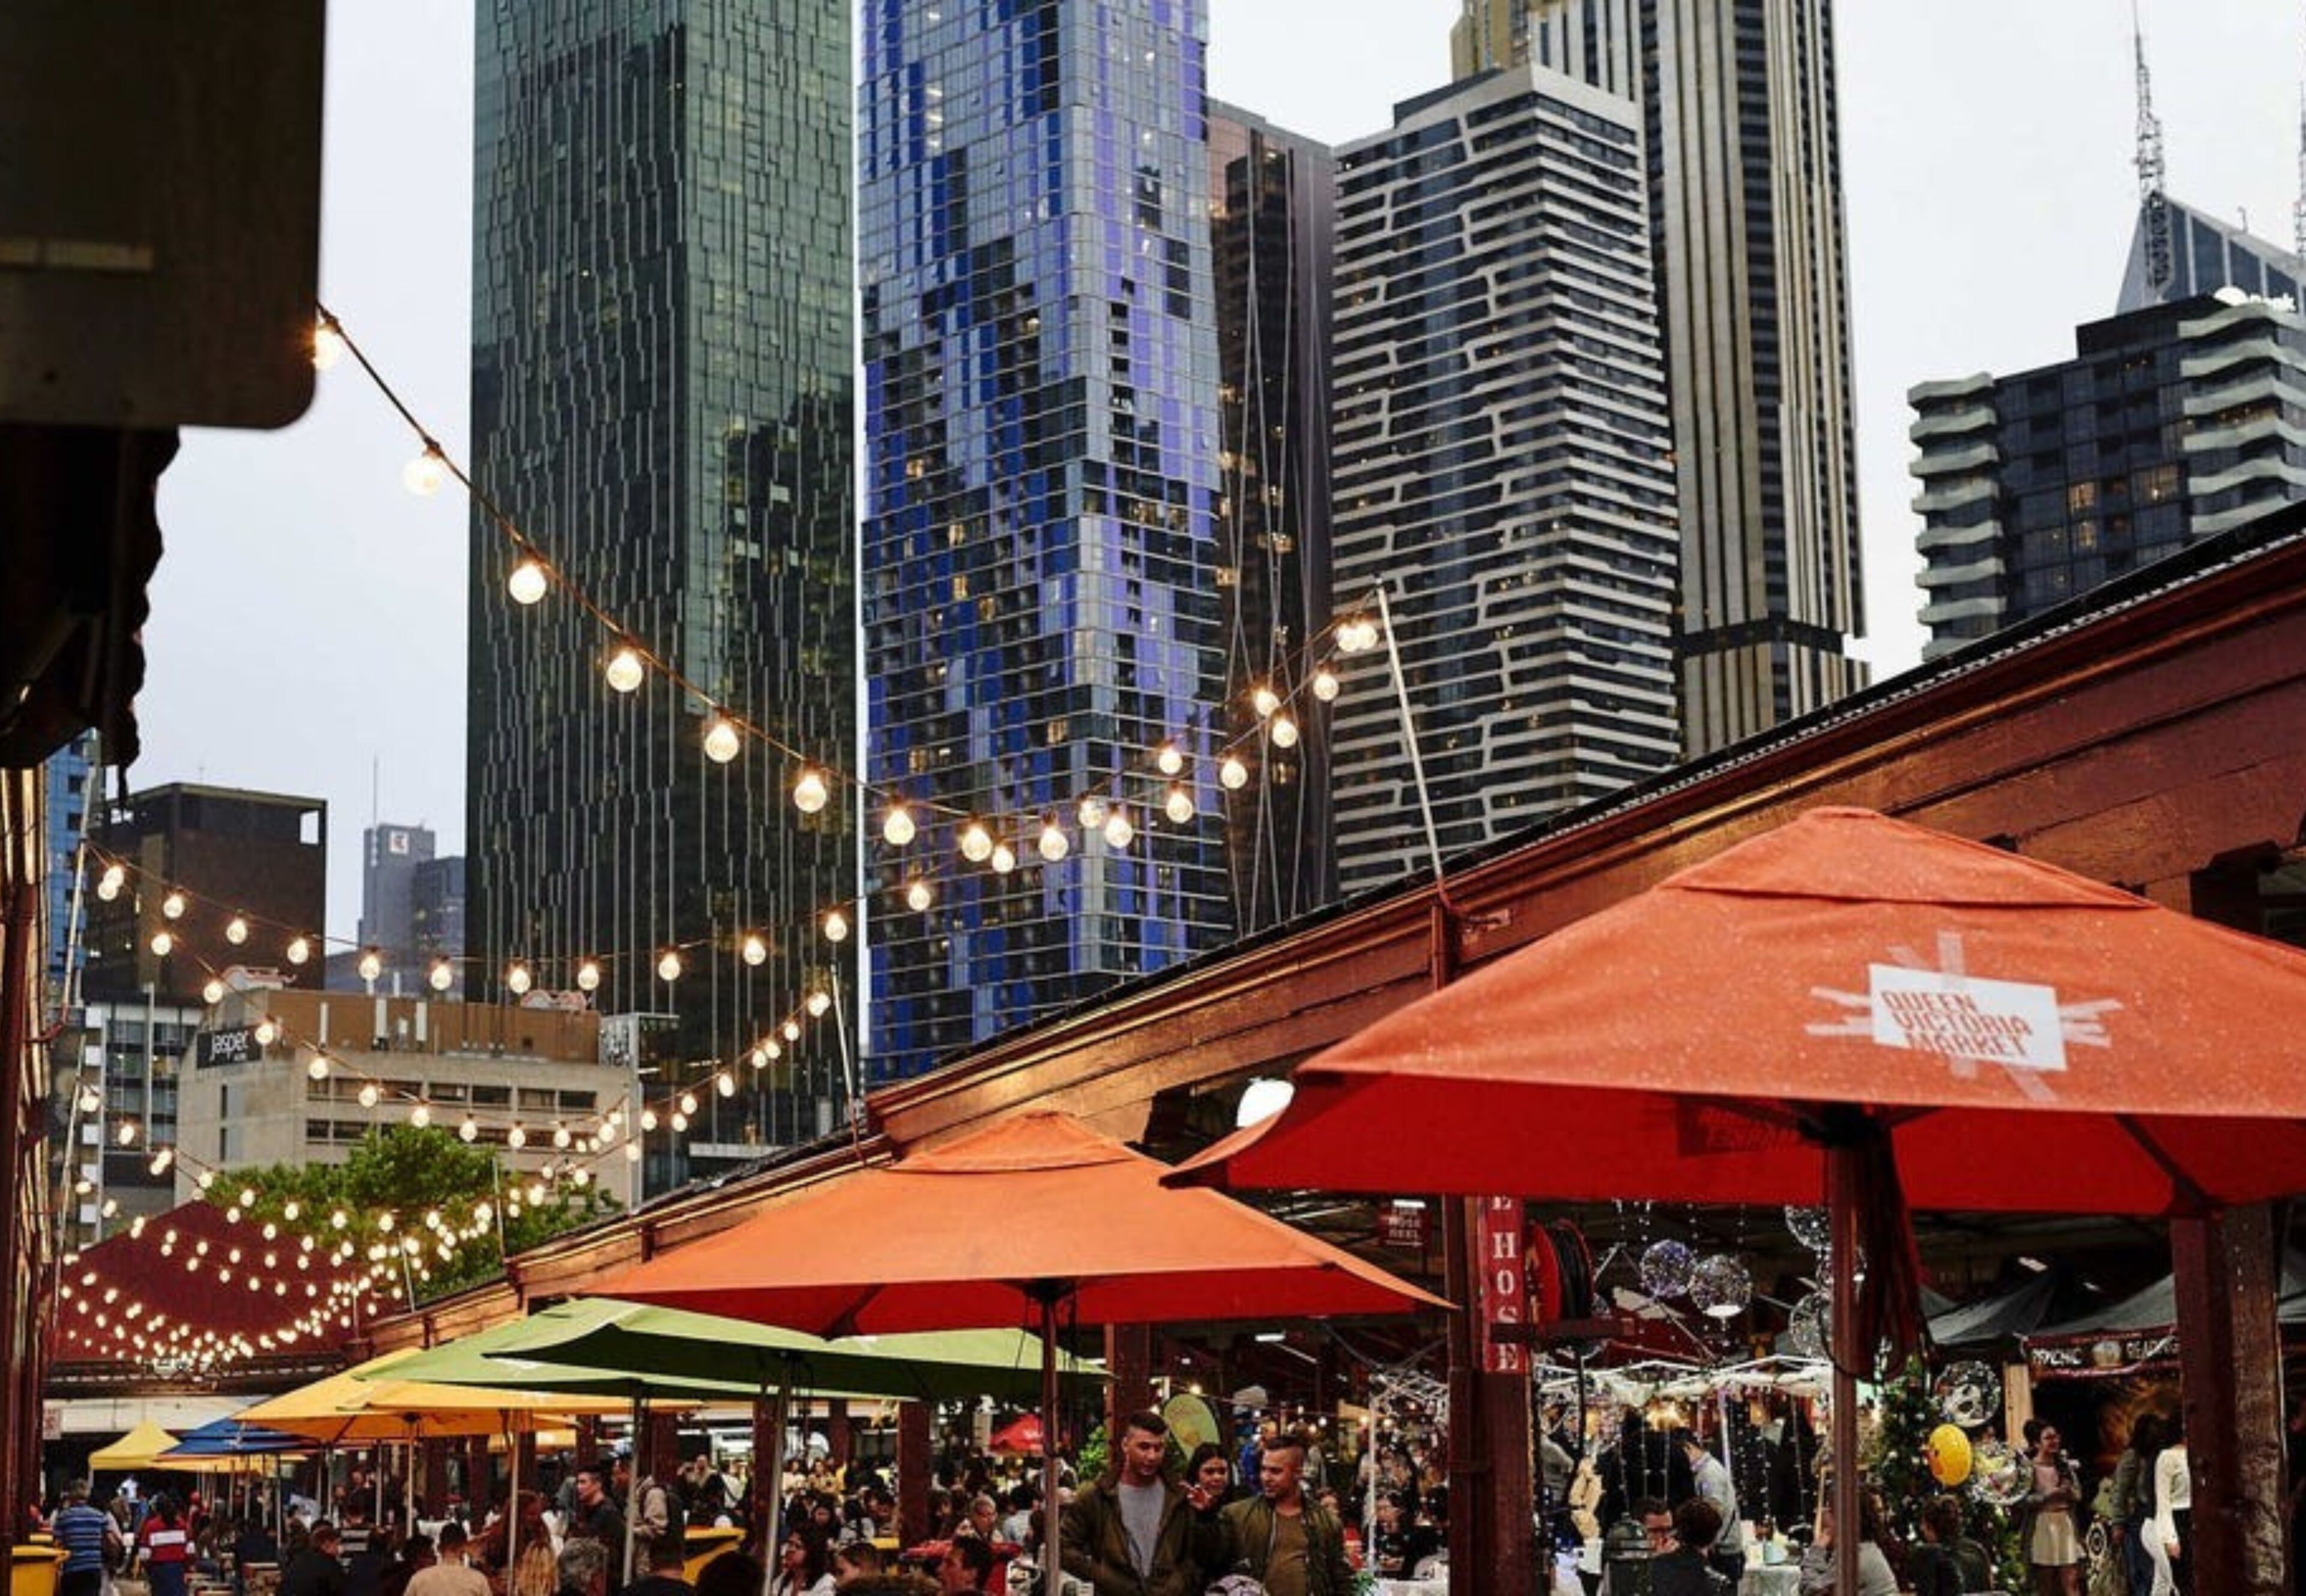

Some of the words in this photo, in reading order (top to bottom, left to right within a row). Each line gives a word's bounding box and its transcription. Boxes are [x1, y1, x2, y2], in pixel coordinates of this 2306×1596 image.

[1882, 991, 1978, 1013] QUEEN
[1892, 1012, 2033, 1035] VICTORIA
[1905, 1032, 2026, 1056] MARKET
[1492, 1232, 1519, 1371] HOSE
